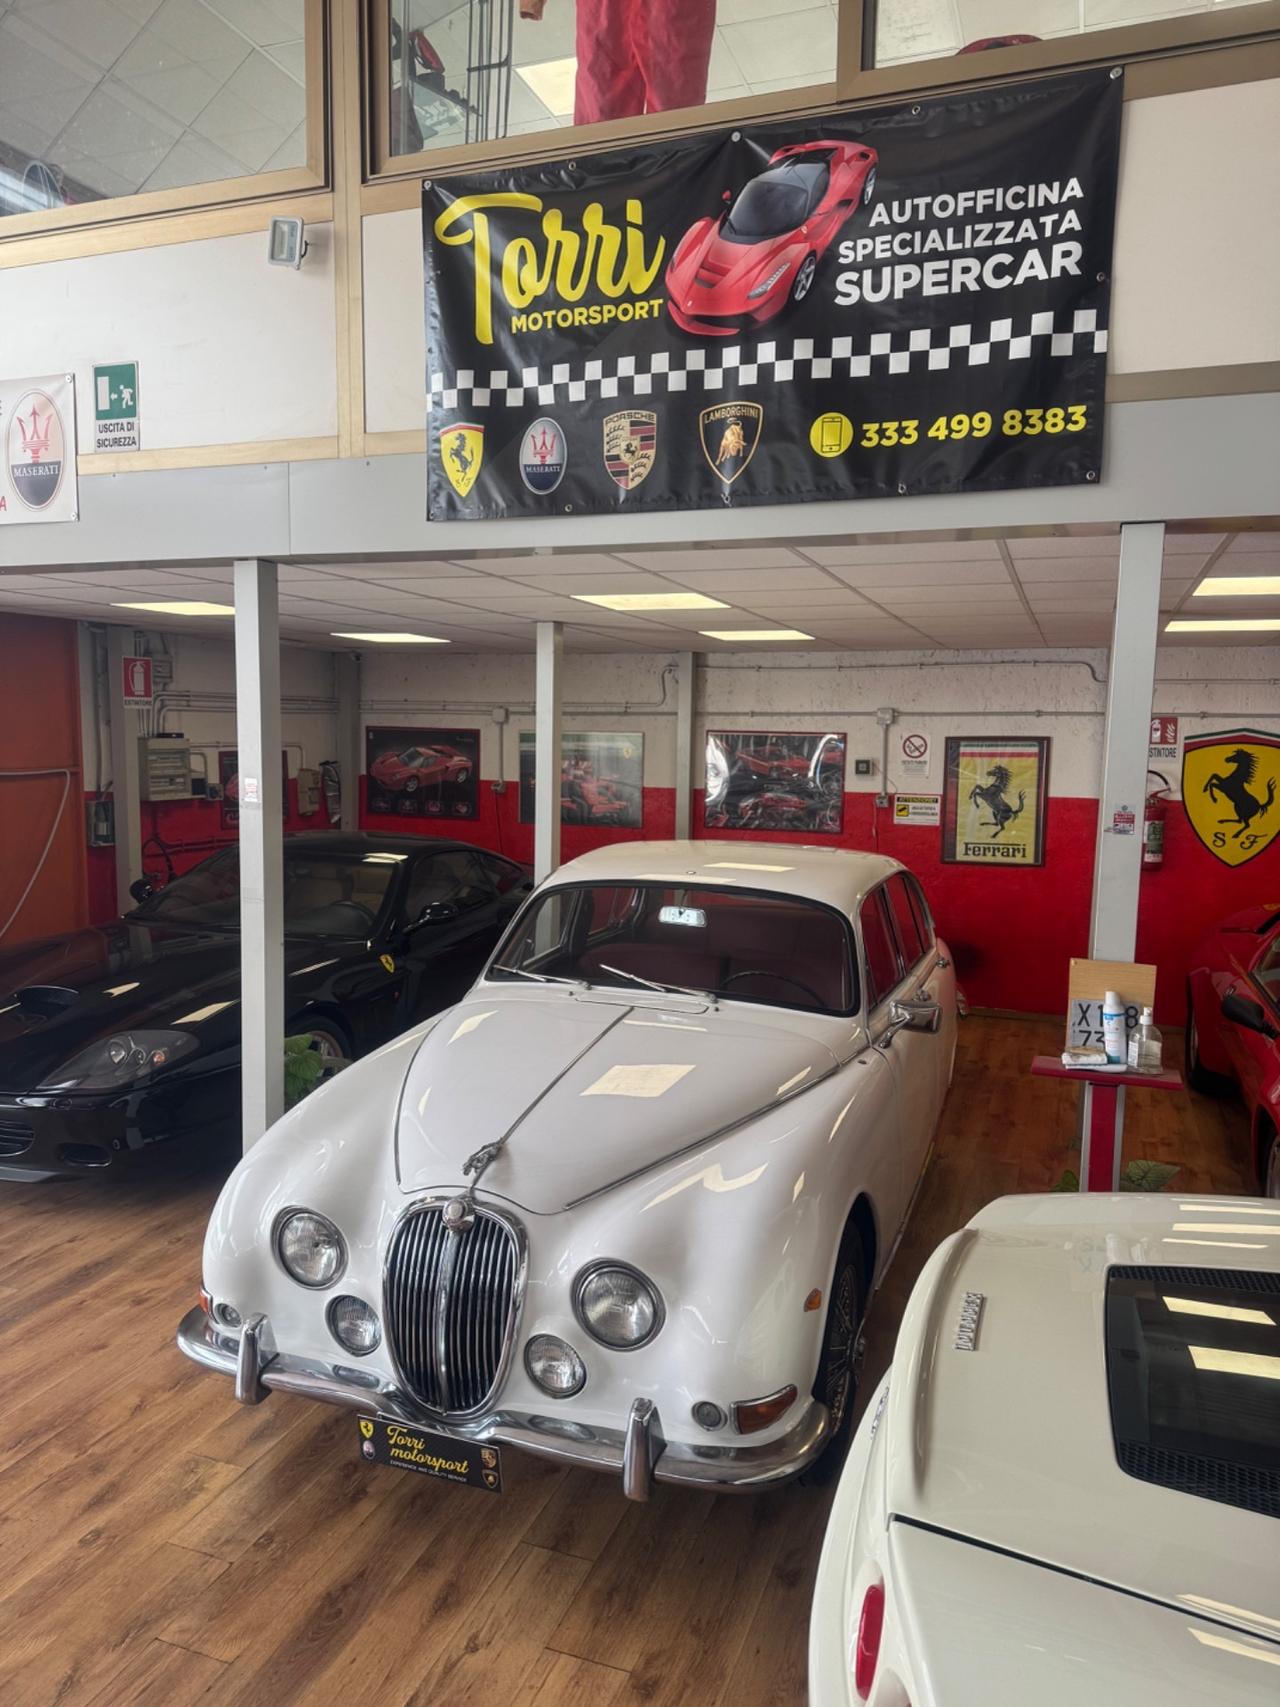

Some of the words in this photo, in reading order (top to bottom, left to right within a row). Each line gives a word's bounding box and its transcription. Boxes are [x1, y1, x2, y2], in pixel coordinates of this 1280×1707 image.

[868, 177, 1084, 227] AUTOFFICINA
[838, 209, 1082, 264] SPECIALIZZATA
[434, 192, 666, 344] Torri
[834, 241, 1083, 306] SUPERCAR
[511, 299, 663, 333] MOTORSPORT
[605, 411, 656, 425] PORSCHE
[704, 405, 759, 424] LAMBORGHINI
[98, 422, 125, 433] USCITA
[126, 421, 135, 431] DI
[860, 420, 919, 448] 333
[927, 411, 992, 440] 499
[1002, 405, 1087, 435] 8383
[96, 436, 137, 448] SICUREZZA
[13, 464, 60, 477] MASERATI
[525, 465, 561, 473] MASERATI
[1148, 747, 1177, 758] STINTORE
[962, 842, 1027, 858] Ferrari
[1212, 832, 1226, 848] S
[1240, 833, 1268, 850] F
[387, 1426, 425, 1448] Torri
[390, 1447, 469, 1474] motorsport
